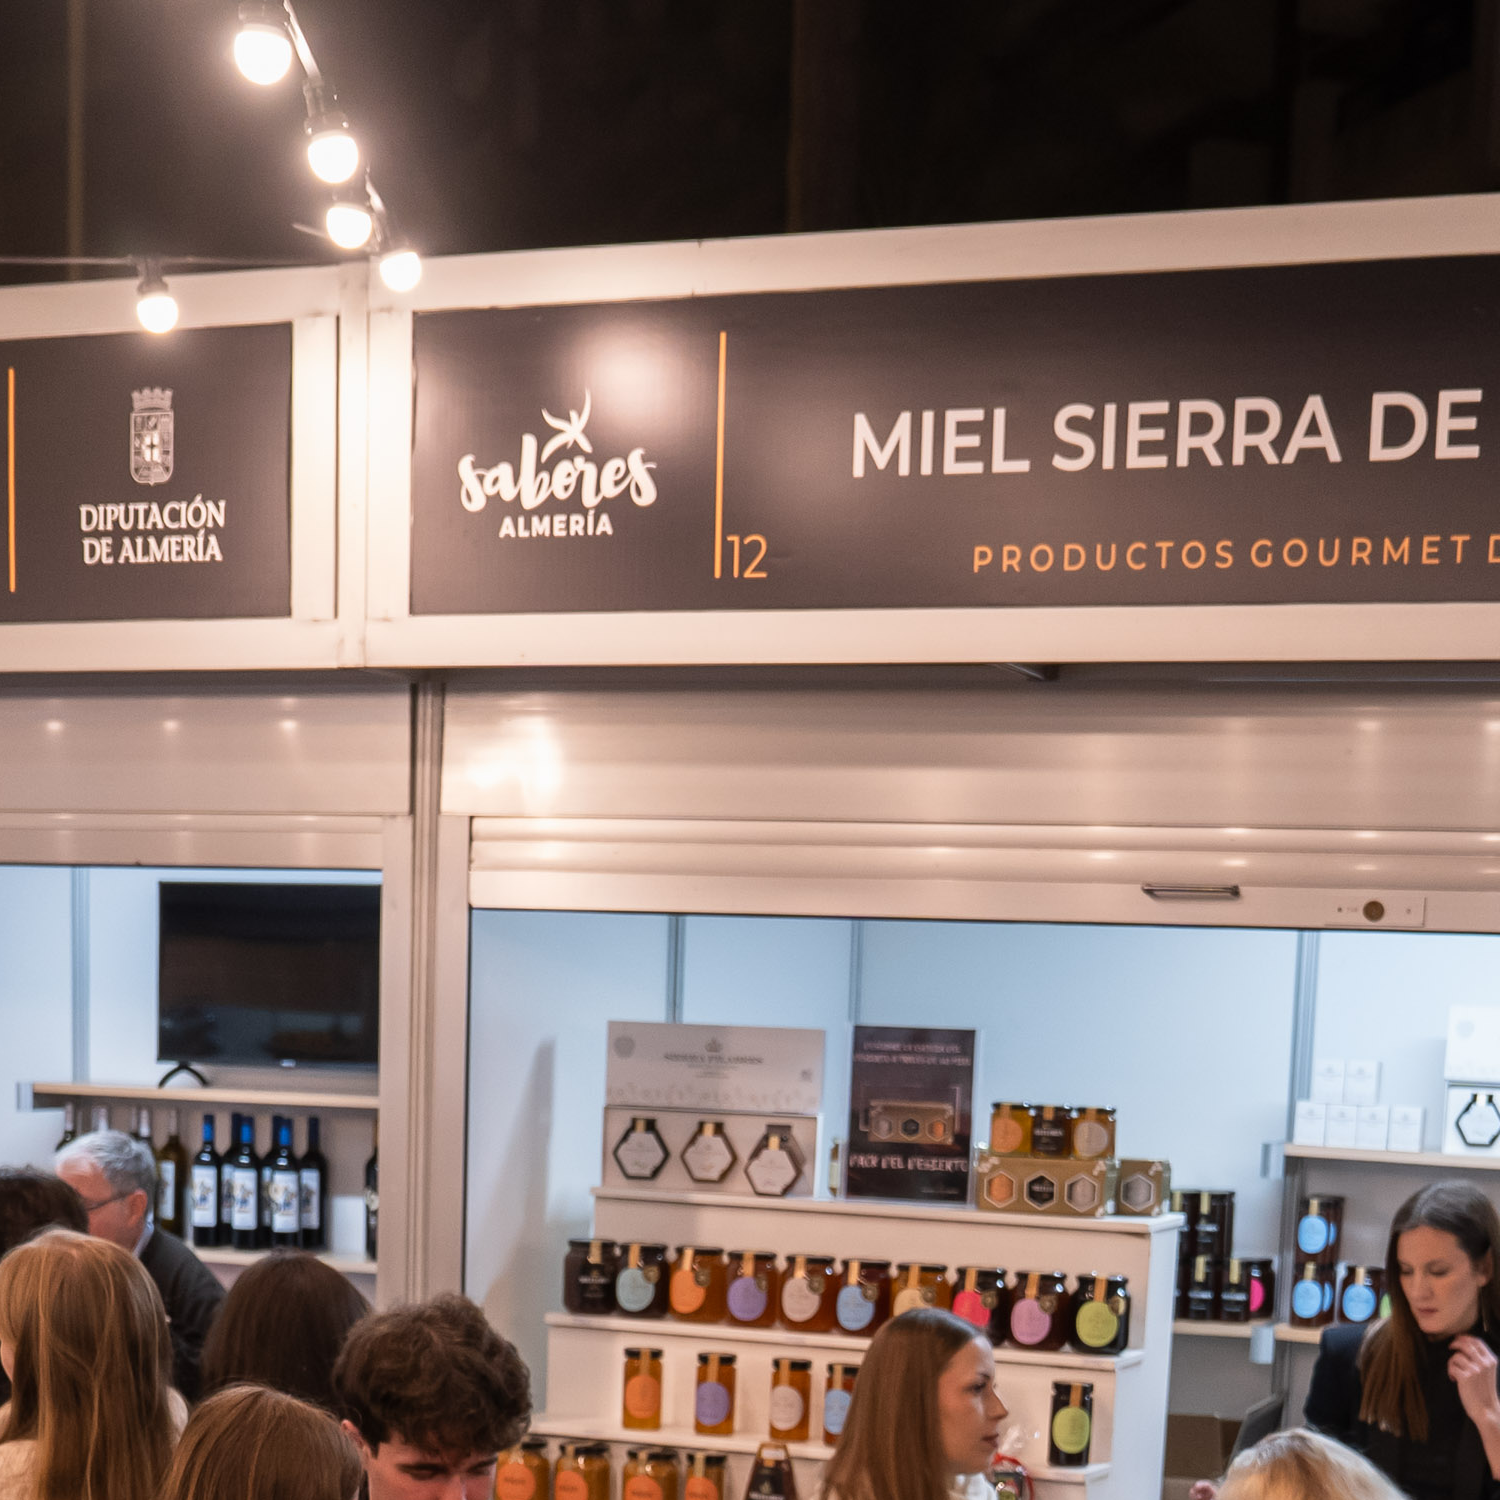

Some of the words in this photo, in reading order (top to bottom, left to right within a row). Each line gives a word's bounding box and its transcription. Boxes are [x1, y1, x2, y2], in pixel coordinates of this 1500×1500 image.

[851, 408, 1031, 478] MIEL
[1051, 395, 1343, 473] SIERRA
[1368, 388, 1483, 462] DE
[457, 434, 657, 512] sabores
[79, 494, 227, 532] DIPUTACIÓN
[498, 508, 614, 539] ALMERÍA
[82, 537, 114, 565] DE
[117, 529, 225, 565] ALMERÍA
[726, 533, 768, 579] 12
[973, 541, 1234, 574] PRODUCTOS
[1250, 534, 1471, 569] GOURMET
